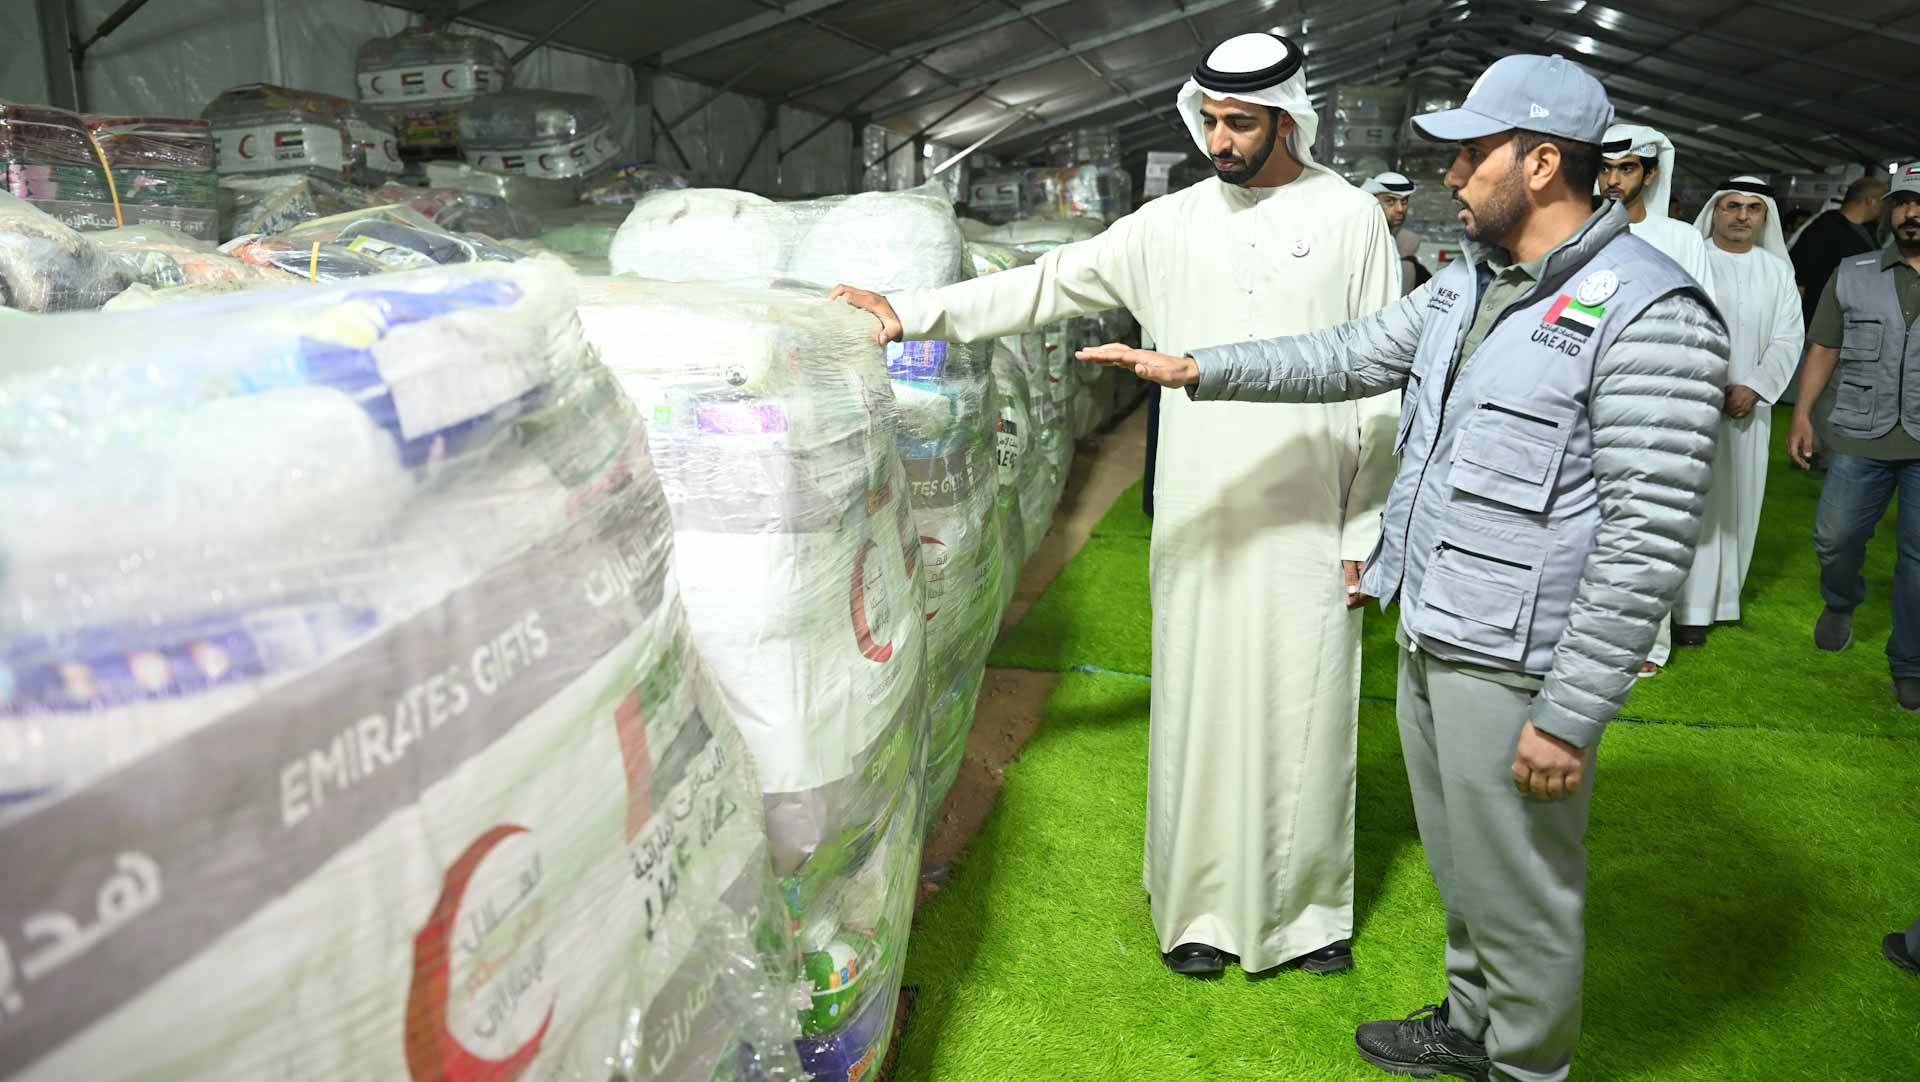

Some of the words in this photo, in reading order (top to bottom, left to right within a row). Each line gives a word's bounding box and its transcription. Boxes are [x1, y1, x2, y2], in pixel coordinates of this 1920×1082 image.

[1531, 329, 1559, 350] UAE
[1554, 339, 1582, 357] AID
[280, 665, 469, 828] EMIRATES
[471, 610, 549, 695] GIFTS
